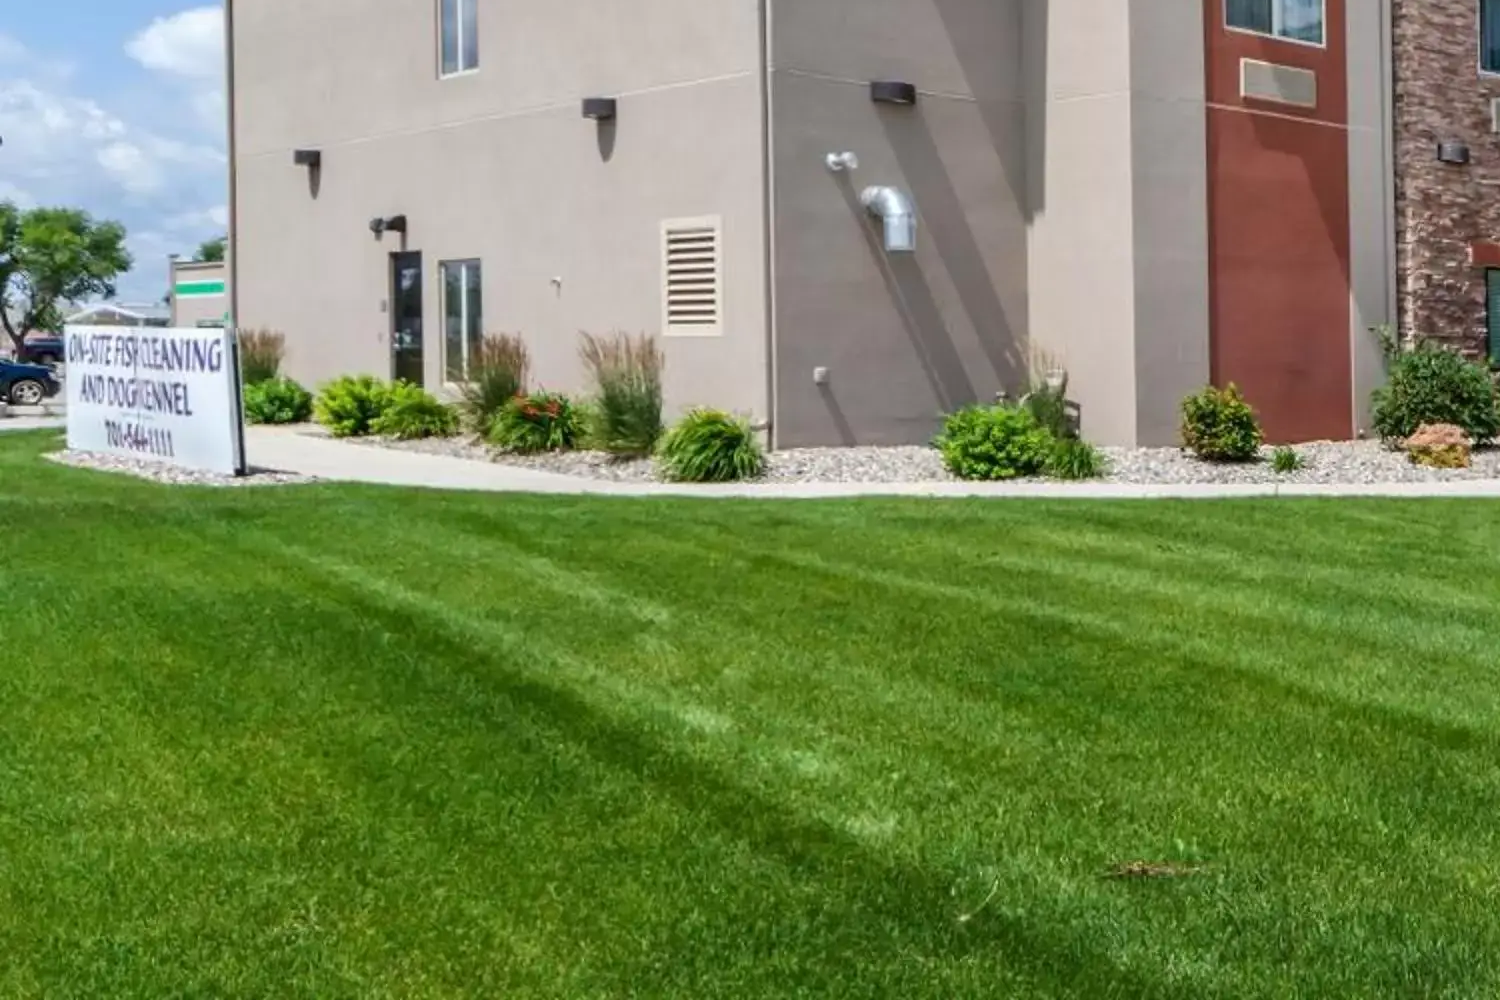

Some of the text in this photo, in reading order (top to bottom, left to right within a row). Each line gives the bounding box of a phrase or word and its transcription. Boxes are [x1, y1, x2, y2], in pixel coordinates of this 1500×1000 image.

[69, 333, 113, 367] ON-SITE
[141, 336, 222, 373] CLEANING
[81, 373, 105, 404] AND
[107, 376, 137, 408] DOG
